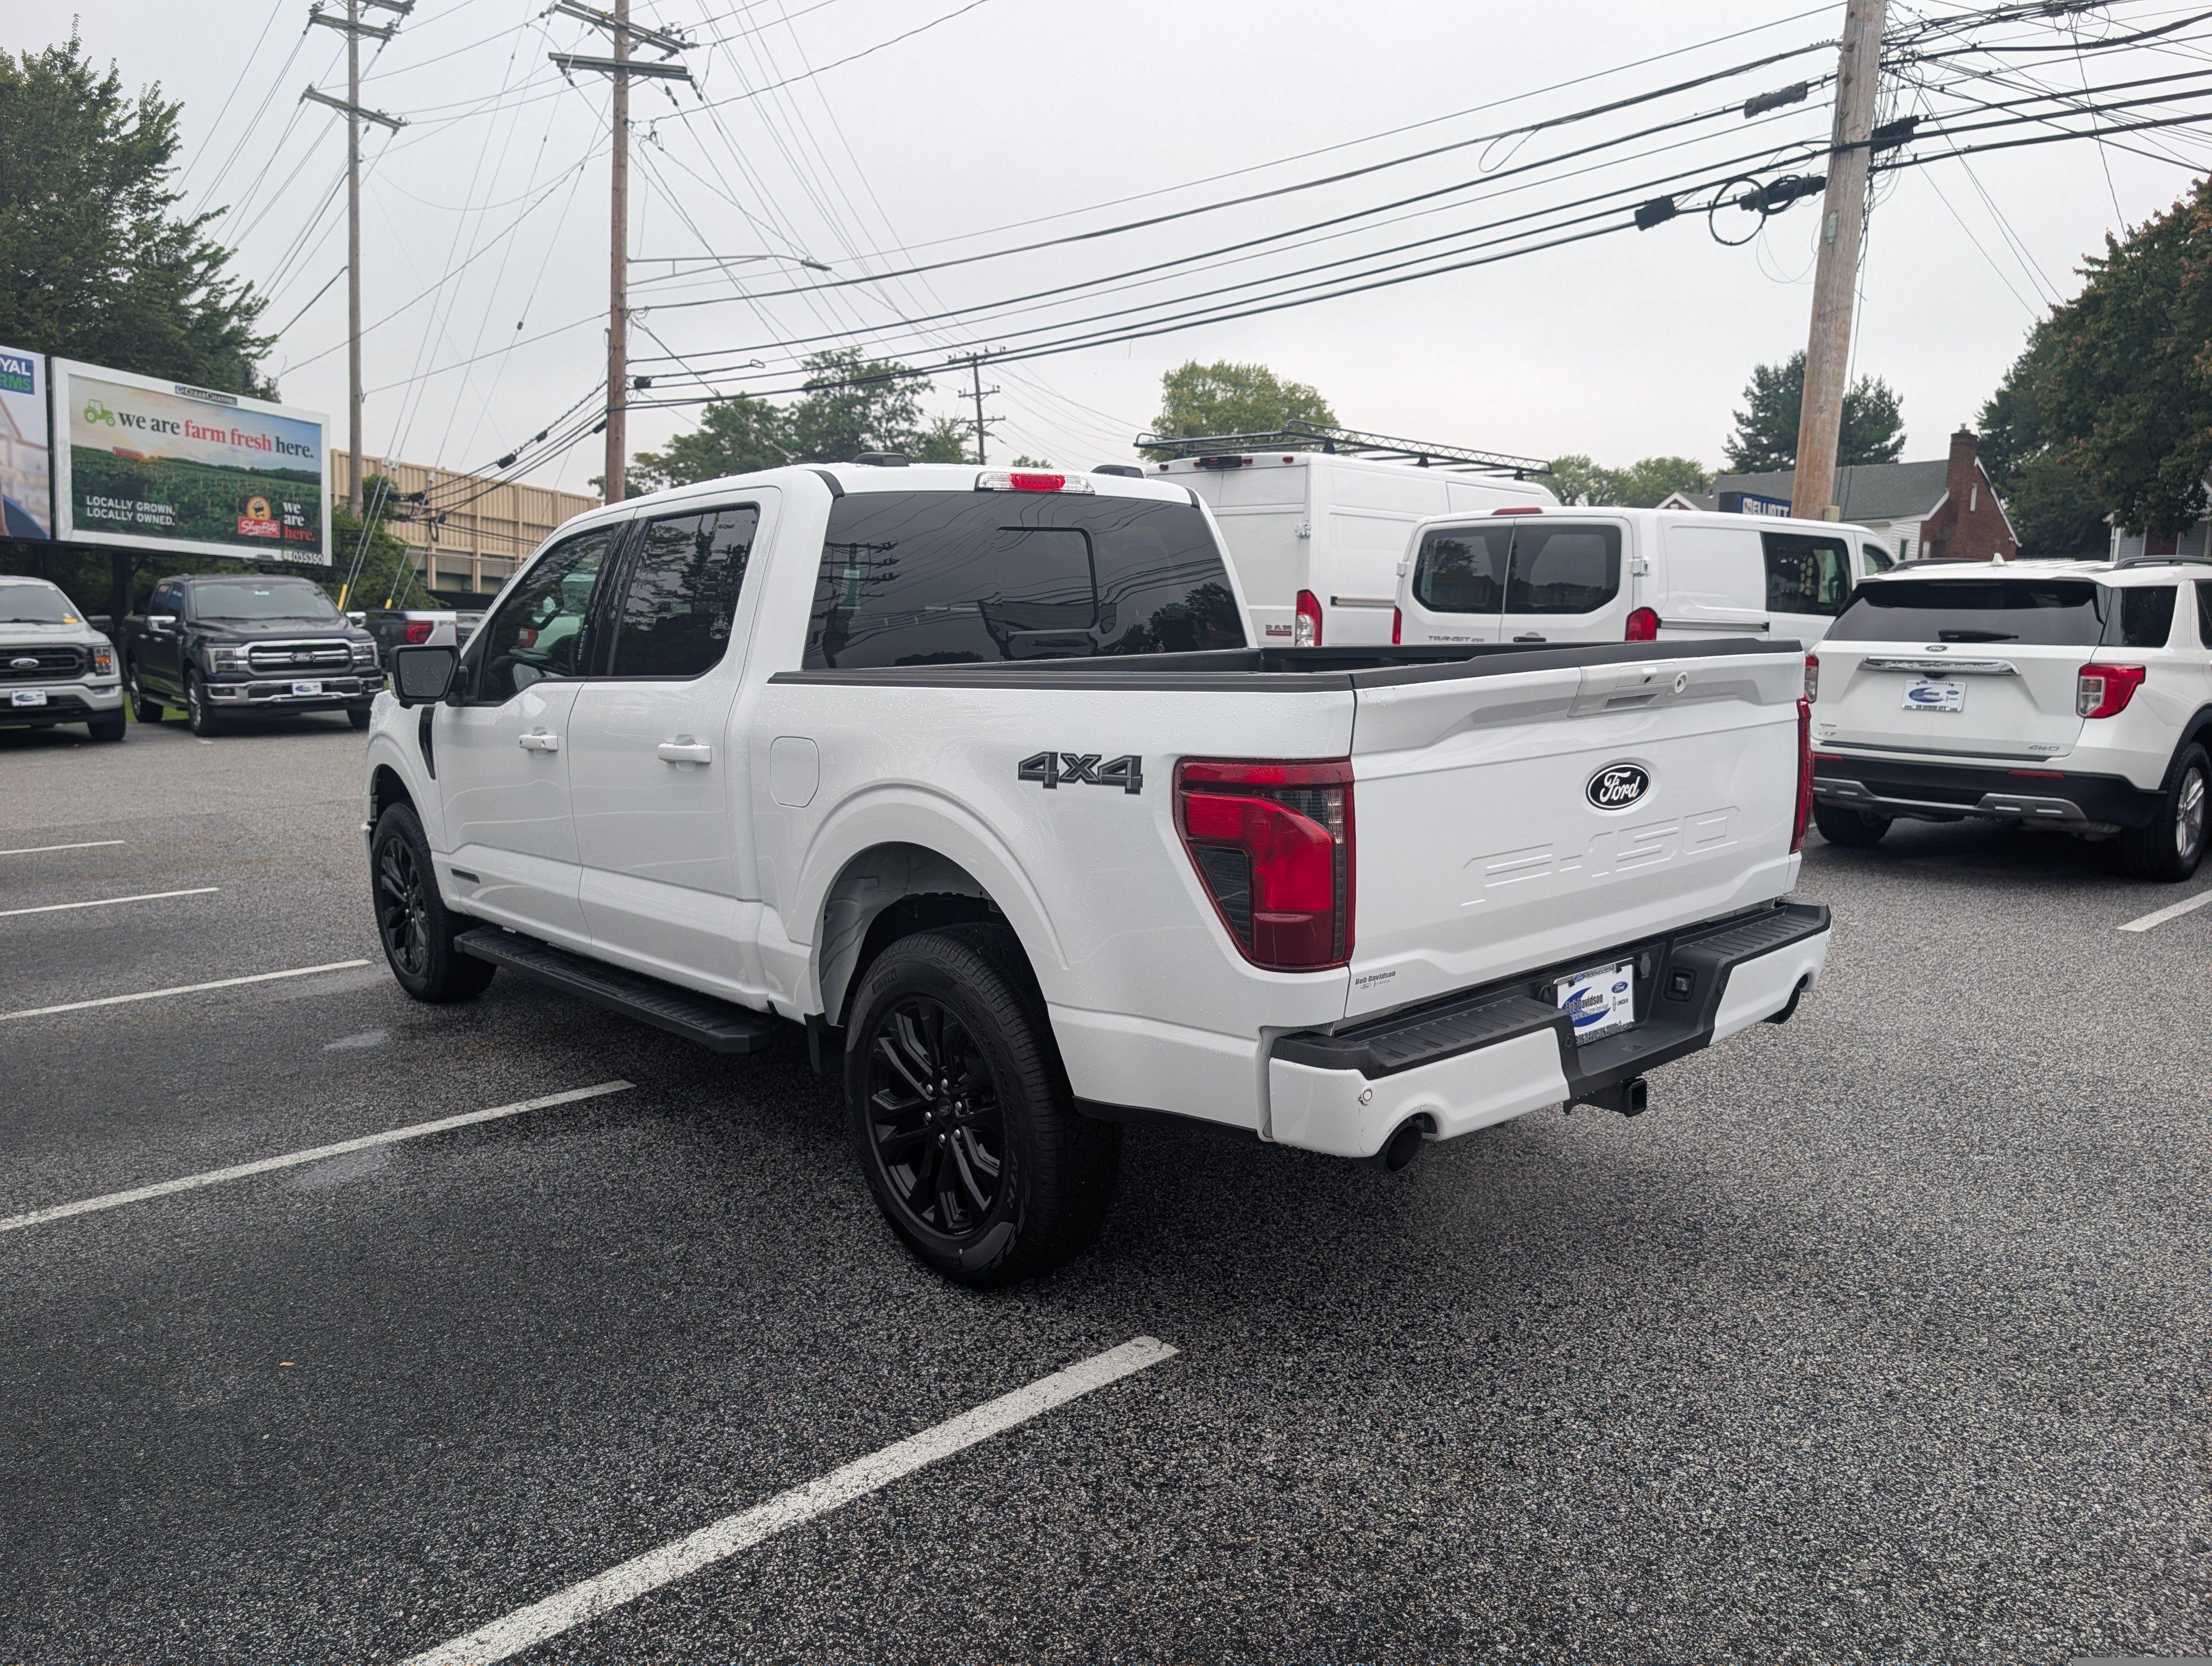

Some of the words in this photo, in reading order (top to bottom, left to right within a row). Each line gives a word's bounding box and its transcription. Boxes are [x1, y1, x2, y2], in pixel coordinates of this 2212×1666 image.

[118, 412, 146, 430] we
[151, 418, 181, 435] are
[184, 419, 226, 443] farm
[230, 428, 272, 451] fresh
[275, 435, 314, 458] here.
[87, 495, 133, 510] LOCALLY
[282, 502, 301, 514] we
[87, 507, 133, 521] LOCALLY
[136, 513, 175, 526] OWNED.
[284, 514, 305, 527] are
[284, 526, 316, 541] here.
[1600, 771, 1641, 802] Ford
[1461, 806, 1741, 906] F-150
[1355, 977, 1367, 985] Bob
[1368, 971, 1396, 982] Davidson
[1566, 998, 1578, 1013] Bob
[1577, 994, 1603, 1009] Davidson
